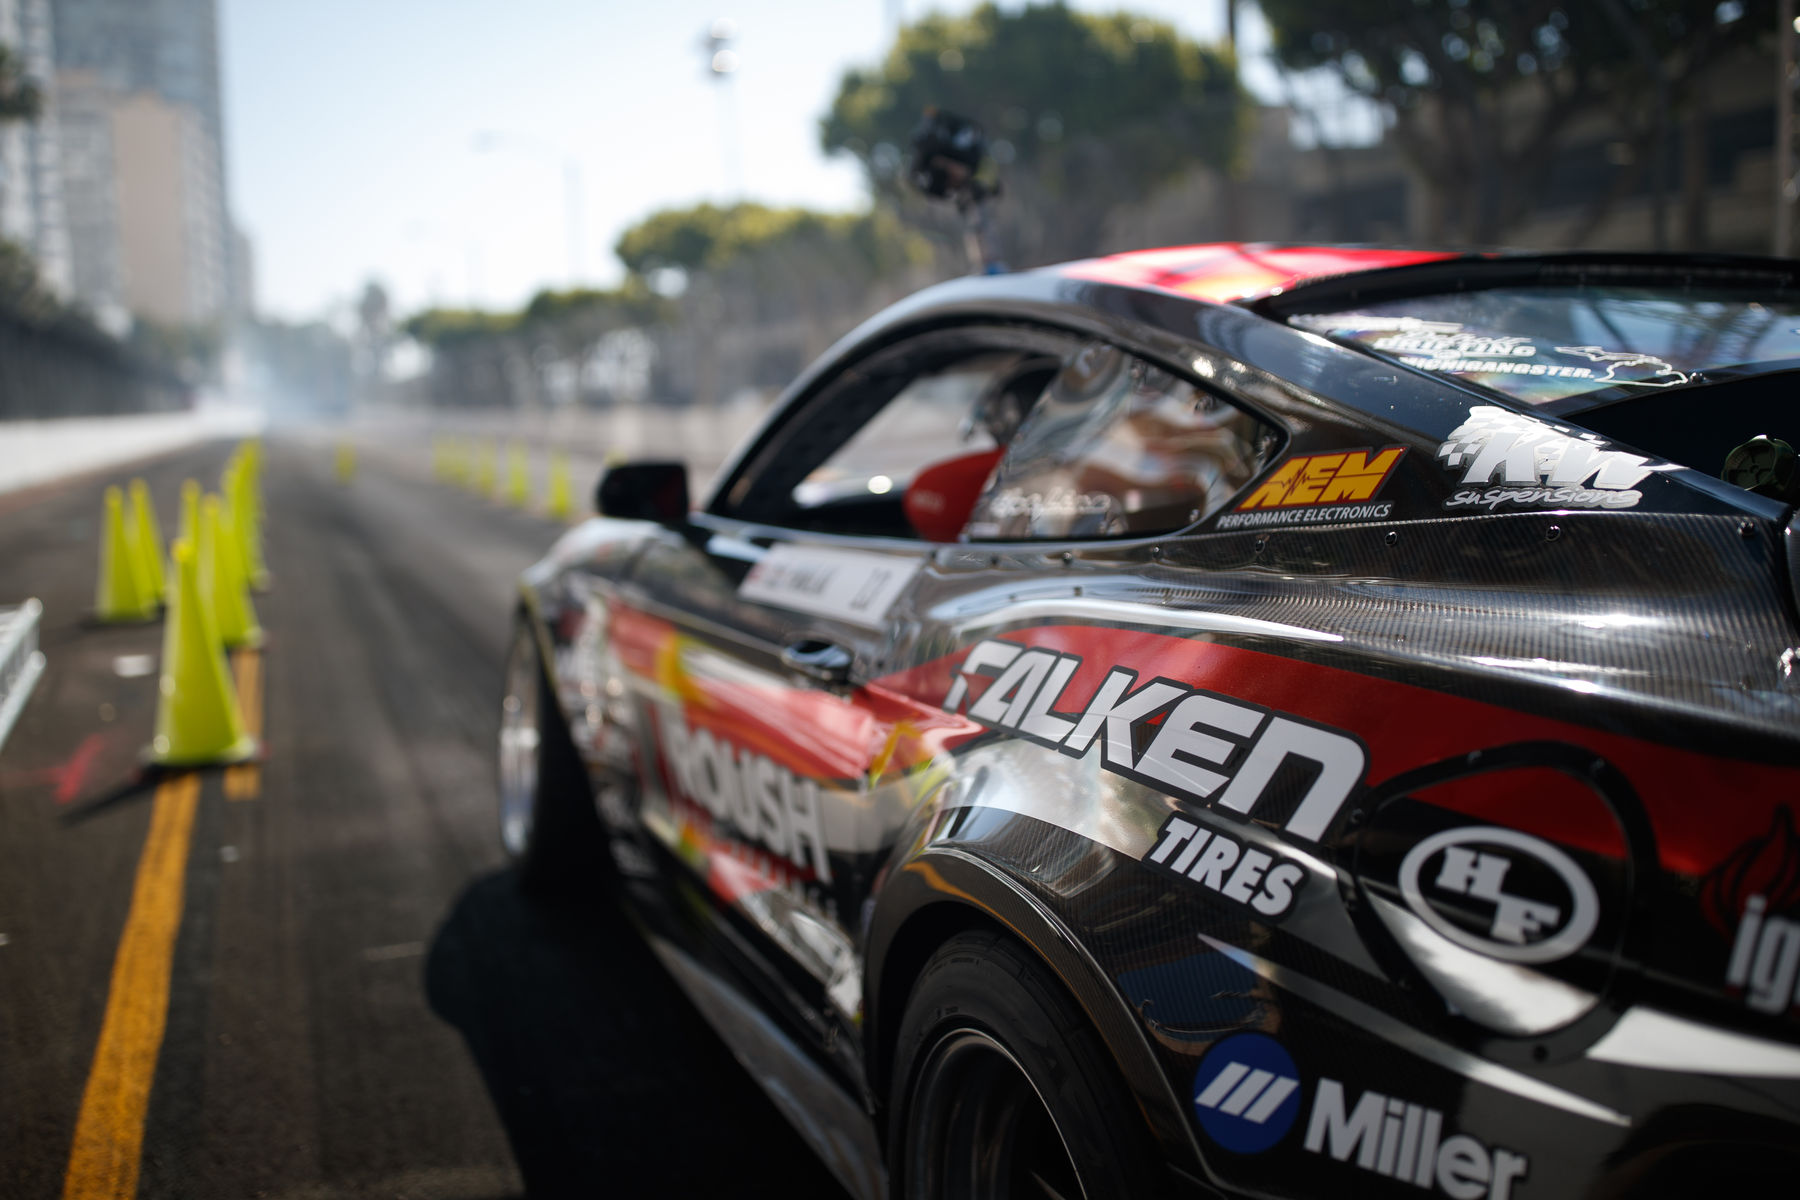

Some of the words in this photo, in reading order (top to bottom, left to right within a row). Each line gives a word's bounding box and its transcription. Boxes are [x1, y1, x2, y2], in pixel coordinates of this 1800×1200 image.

[1217, 508, 1308, 529] PERFORMANCE
[1303, 503, 1392, 522] ELECTRONICS
[1236, 447, 1406, 511] AEM
[943, 639, 1367, 843] FALKEN
[1149, 816, 1304, 917] TIRES
[1725, 894, 1800, 1015] ig
[1304, 1077, 1527, 1200] Miller
